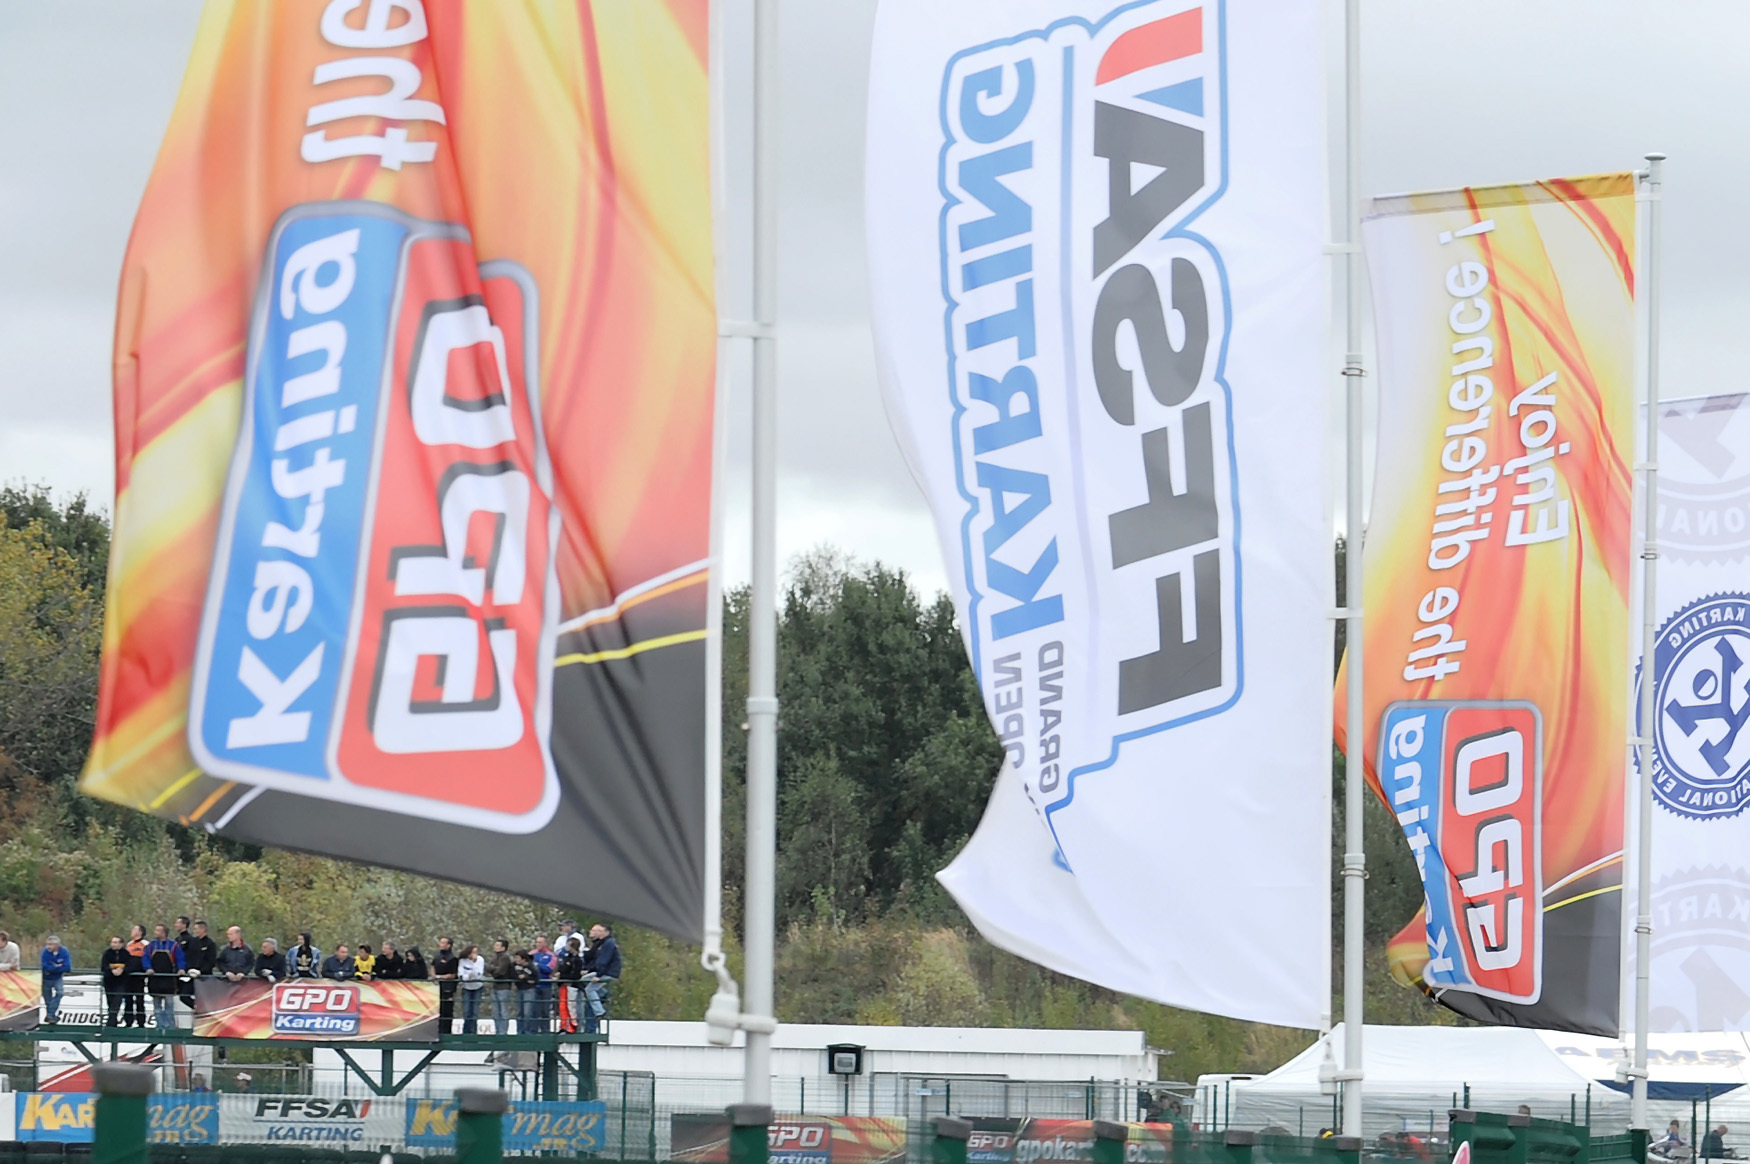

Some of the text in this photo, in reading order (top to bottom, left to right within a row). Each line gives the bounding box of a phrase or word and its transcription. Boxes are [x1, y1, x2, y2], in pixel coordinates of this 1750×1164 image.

[279, 988, 353, 1011] GPO
[275, 1014, 355, 1032] Karting
[255, 1098, 358, 1119] FFSA
[266, 1126, 364, 1142] KARTING
